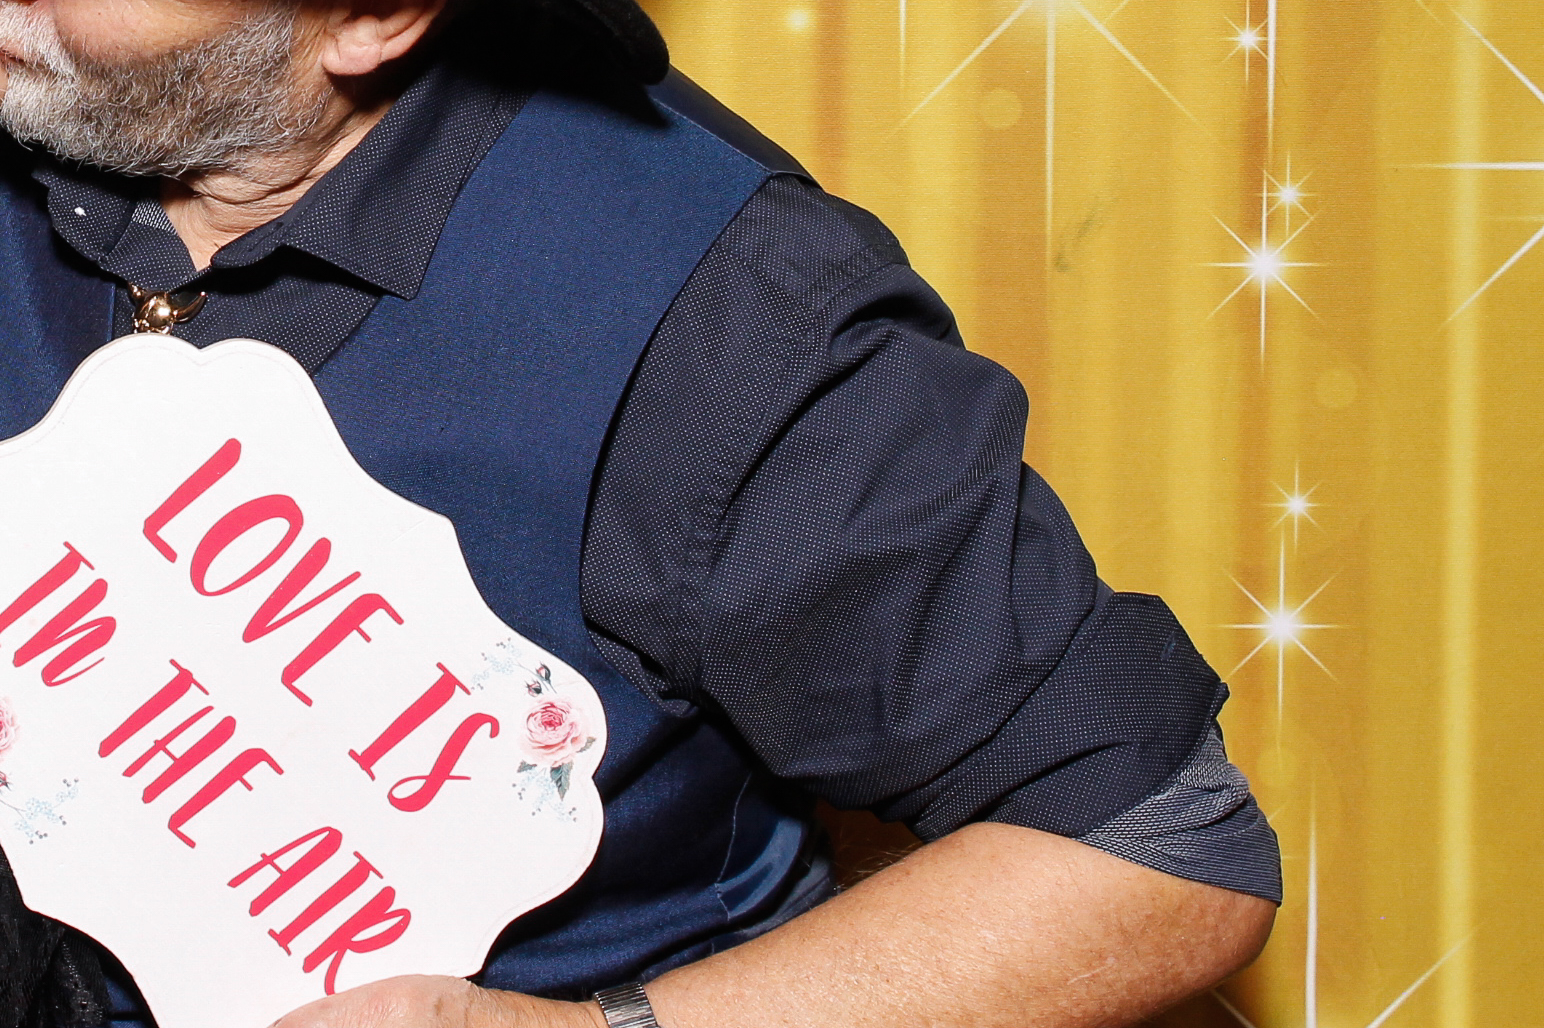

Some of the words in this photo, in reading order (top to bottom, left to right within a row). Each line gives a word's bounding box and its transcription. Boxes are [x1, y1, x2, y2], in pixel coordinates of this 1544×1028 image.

[142, 438, 405, 707] LOVE
[348, 662, 501, 813] IS
[98, 659, 285, 849] THE
[227, 826, 412, 996] AIR
